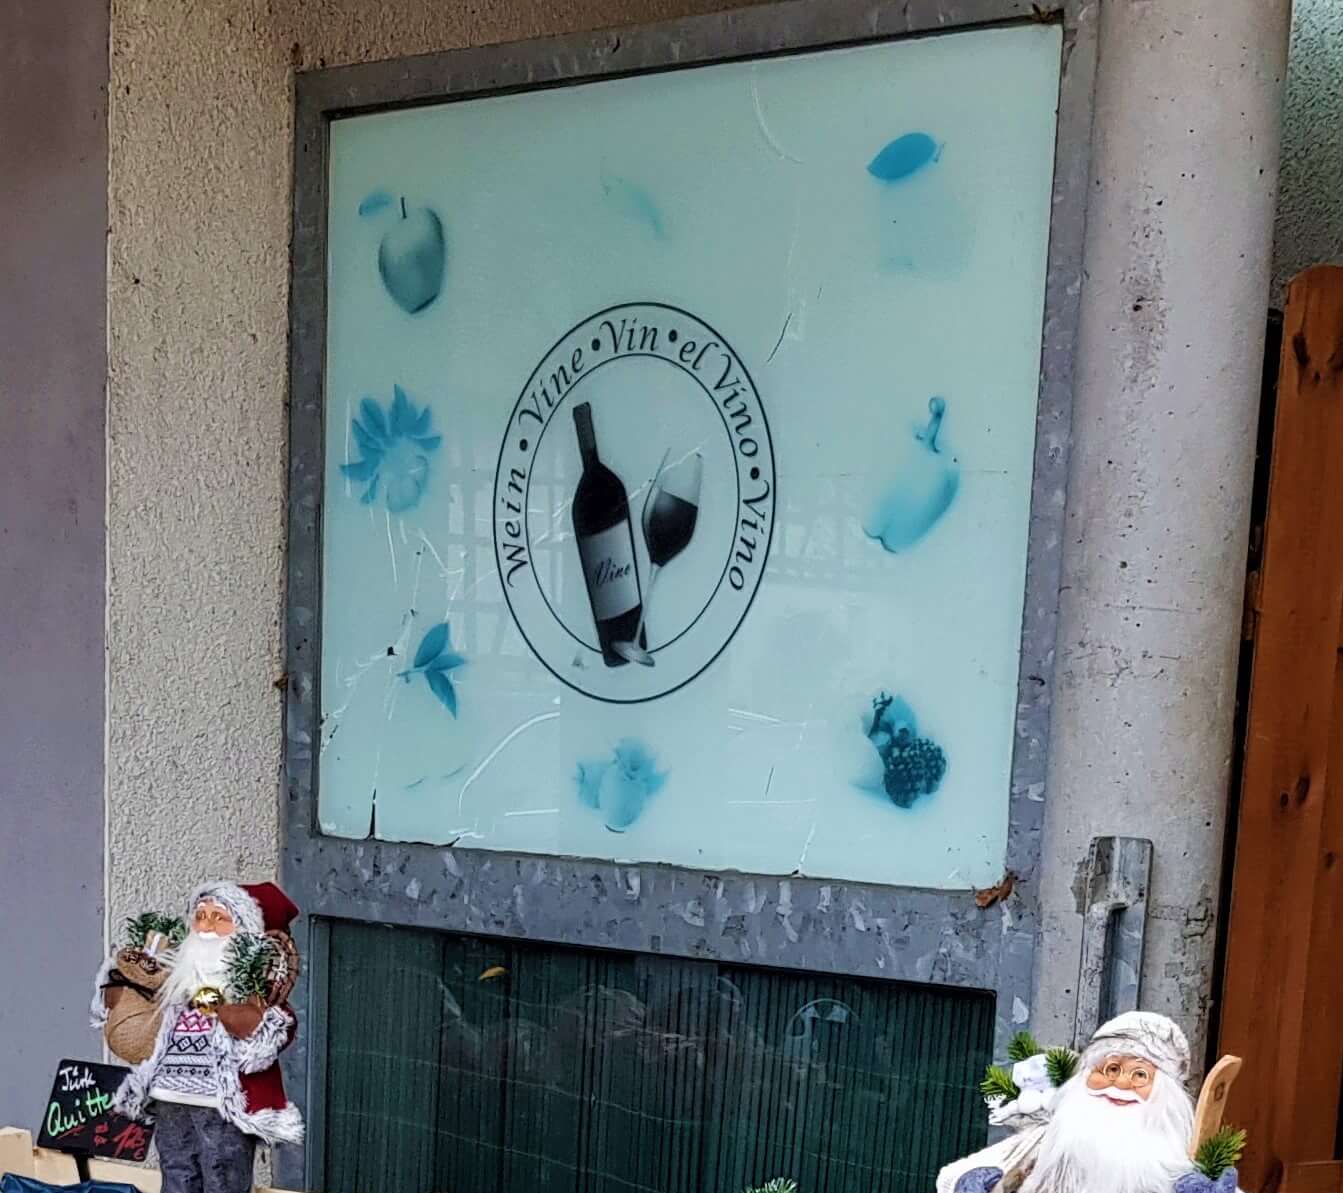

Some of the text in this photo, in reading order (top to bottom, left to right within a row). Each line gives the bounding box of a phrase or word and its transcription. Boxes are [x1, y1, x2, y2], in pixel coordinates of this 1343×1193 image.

[600, 318, 659, 353] Vin
[678, 338, 719, 371] el
[712, 354, 759, 457] Vino
[503, 467, 528, 588] Wein
[729, 479, 771, 591] Vino
[47, 1087, 114, 1136] Quitte
